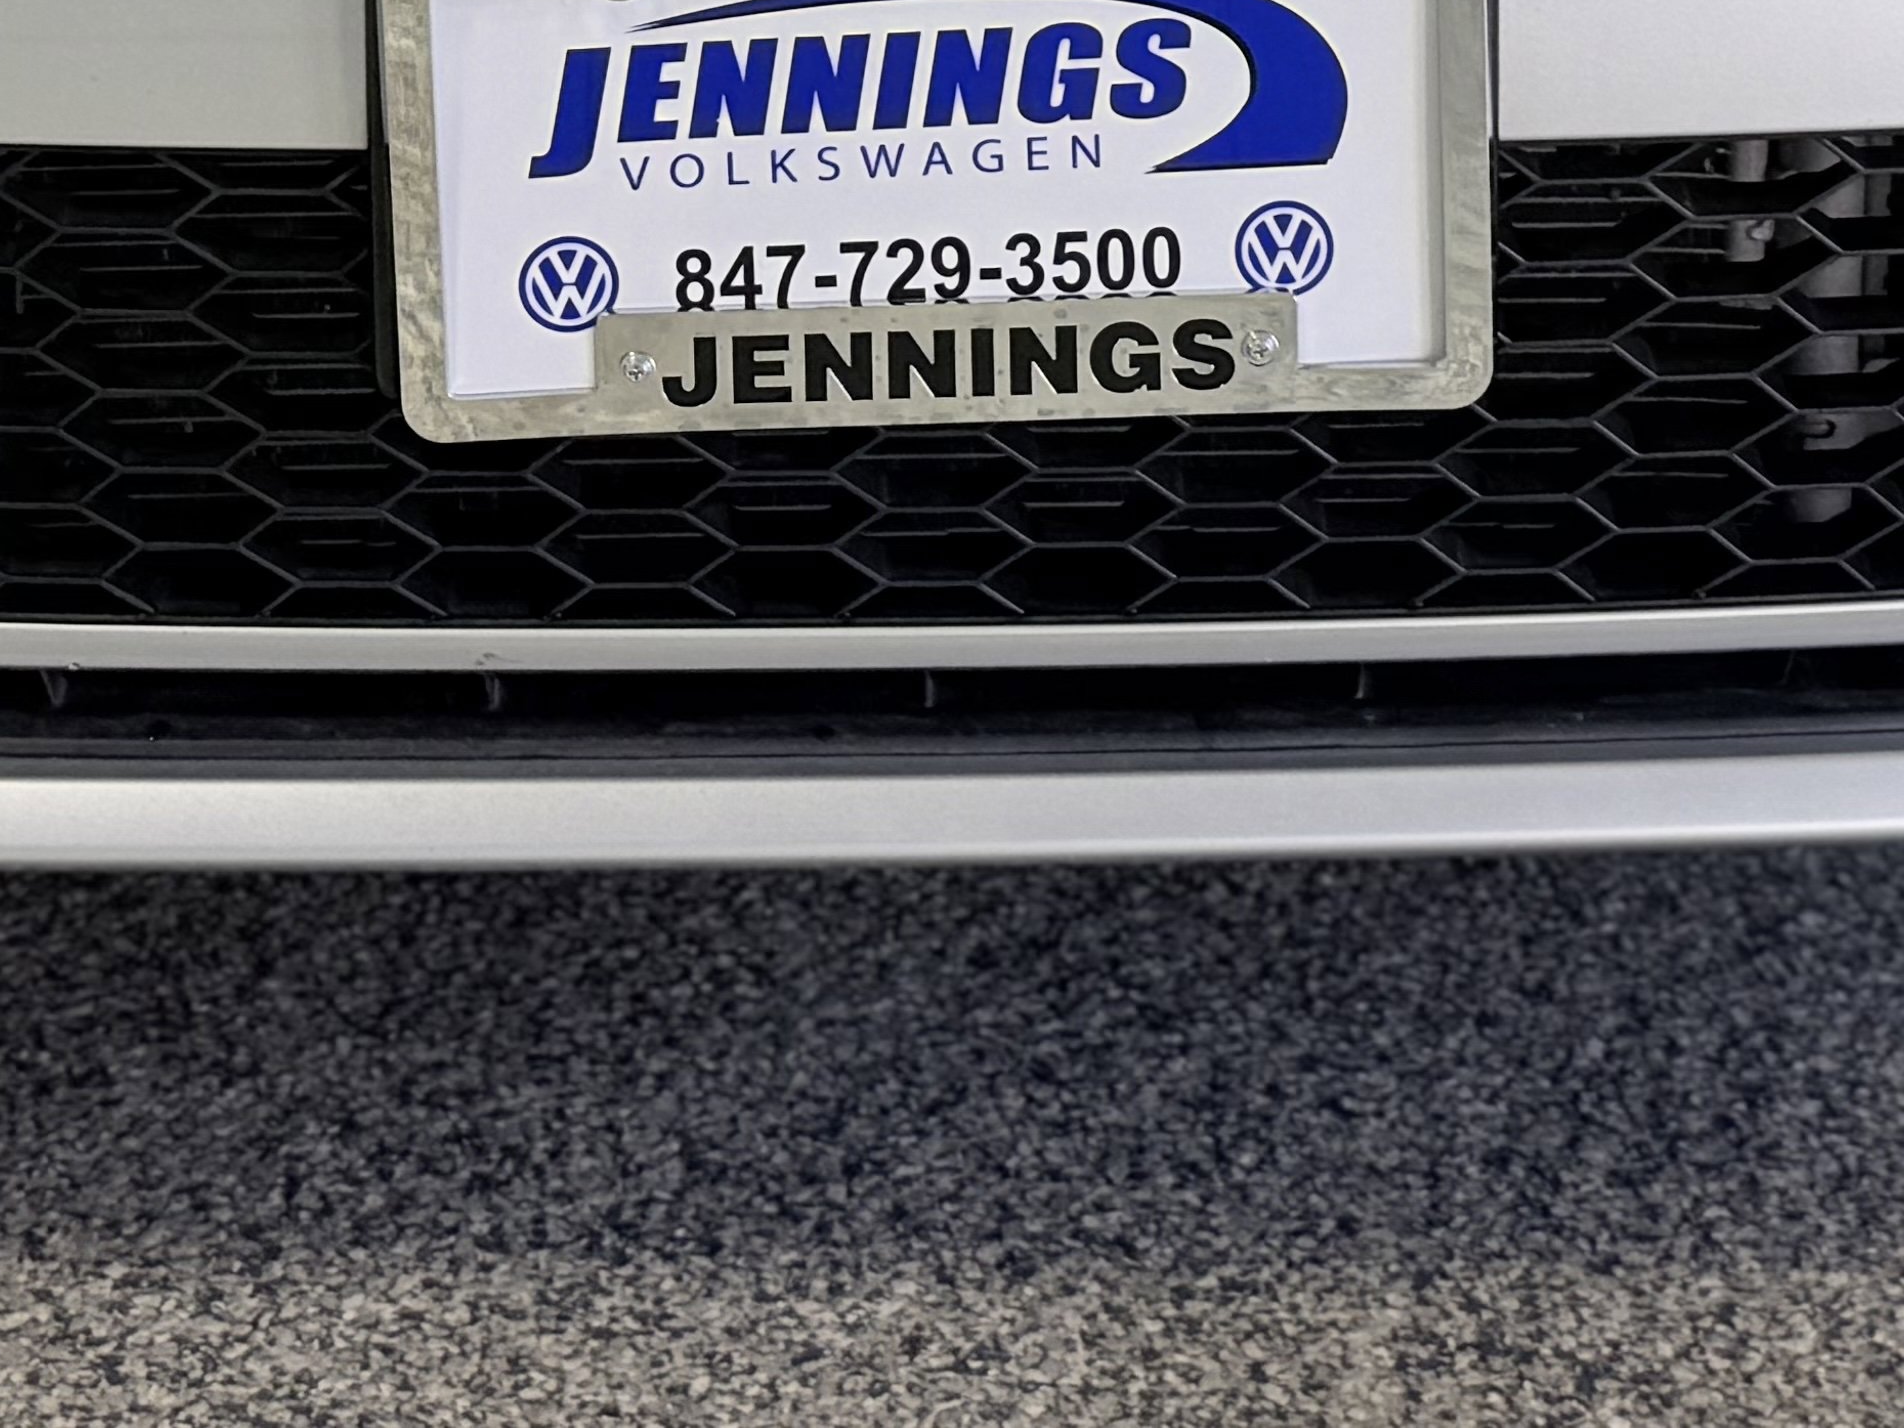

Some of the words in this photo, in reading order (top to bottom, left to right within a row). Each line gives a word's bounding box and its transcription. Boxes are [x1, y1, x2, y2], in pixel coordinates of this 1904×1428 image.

[528, 17, 1193, 180] JENNINGS
[619, 133, 1102, 191] VOLKSWAGEN
[675, 226, 1181, 313] 847-729-3500
[662, 318, 1236, 408] JENNINGS
